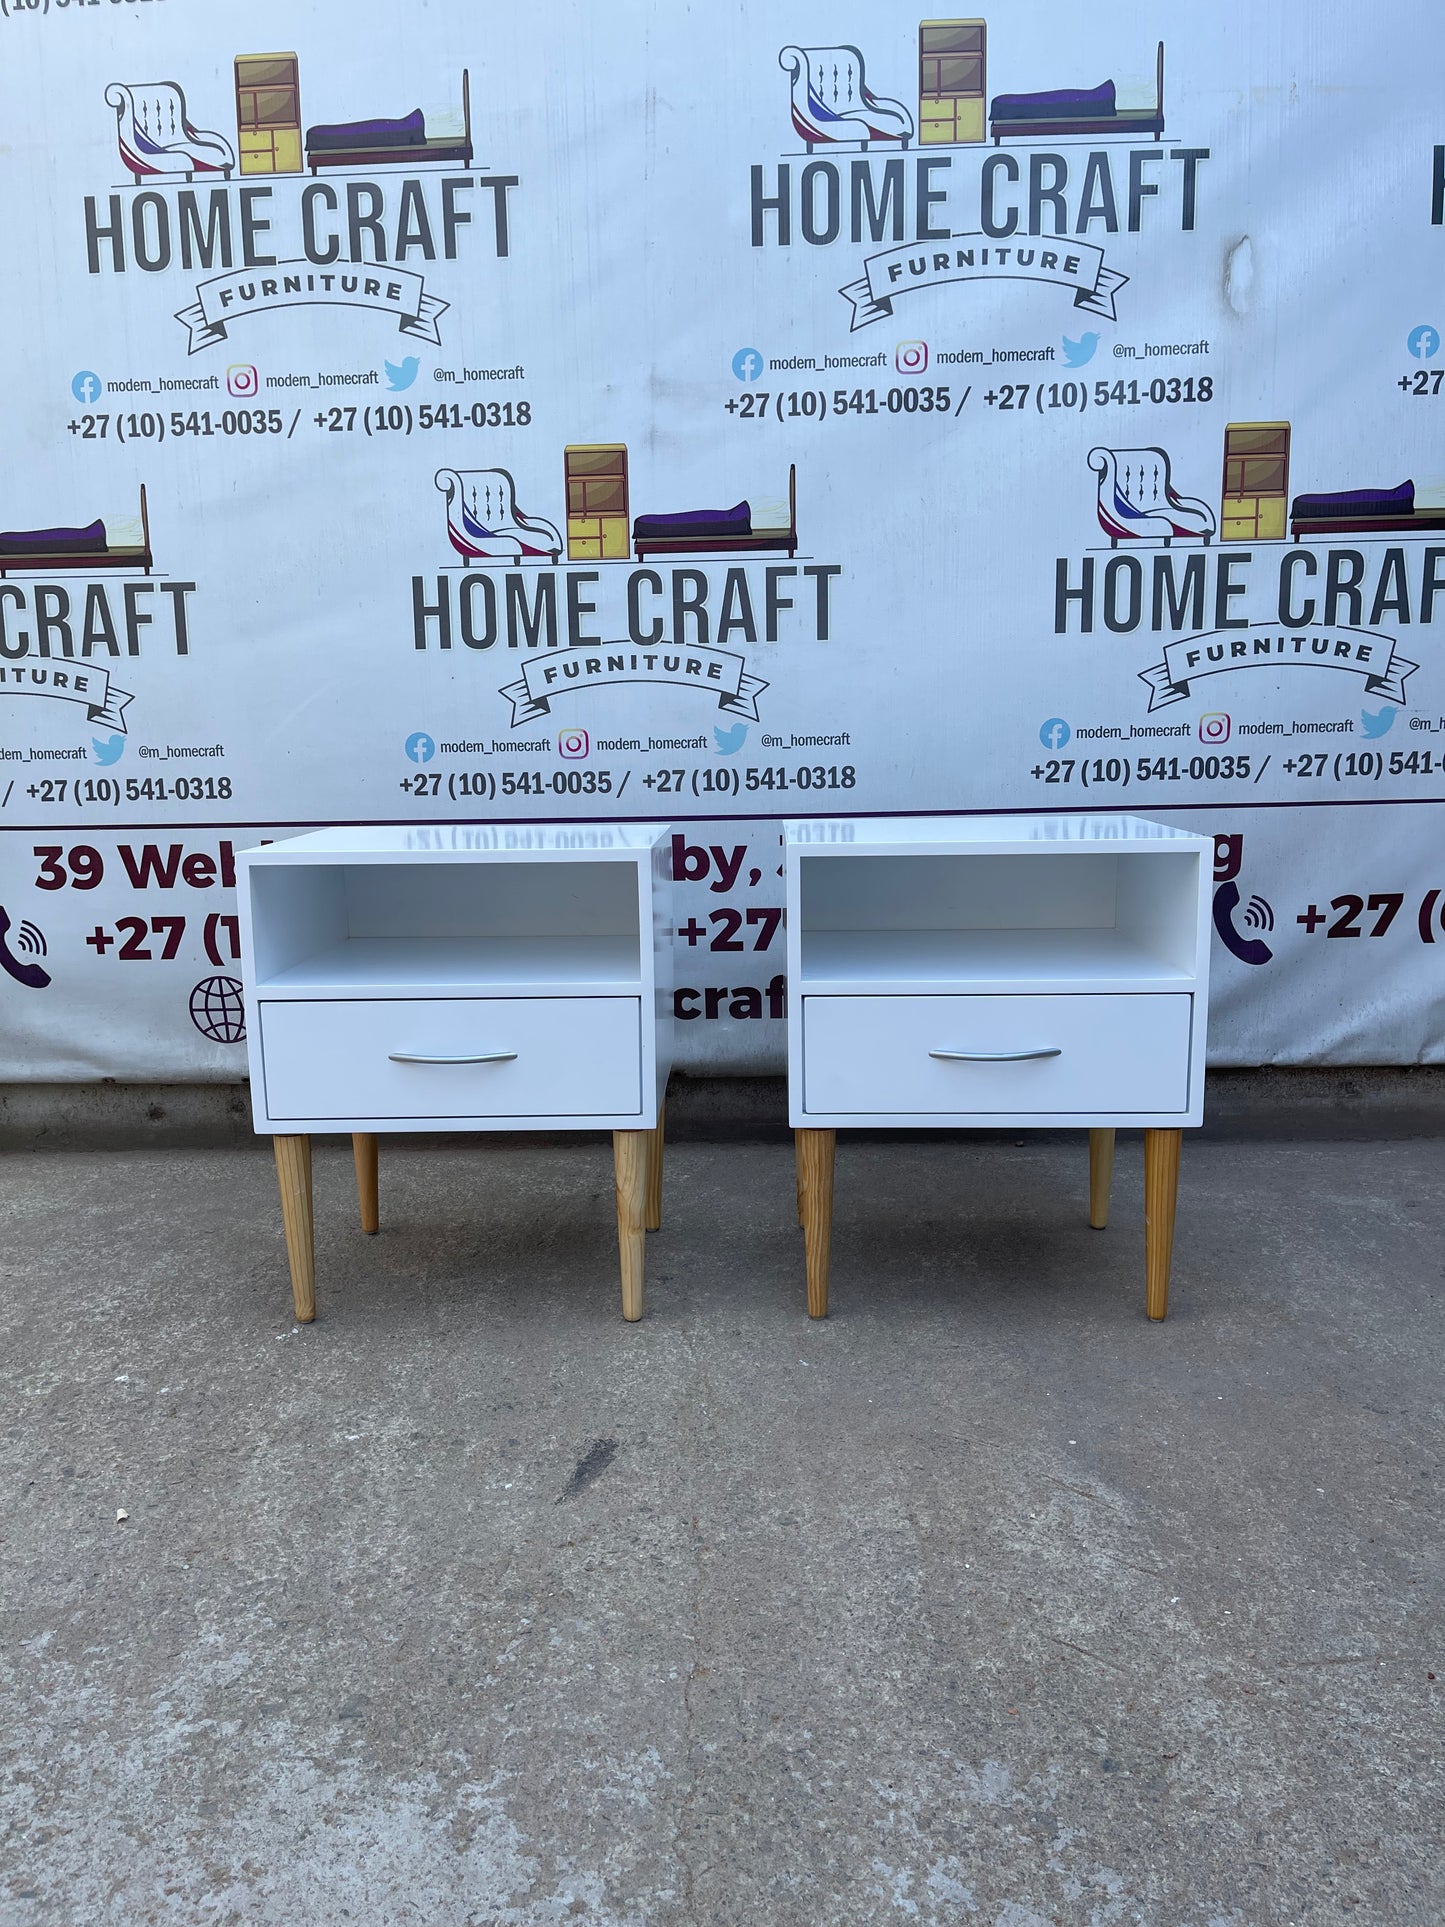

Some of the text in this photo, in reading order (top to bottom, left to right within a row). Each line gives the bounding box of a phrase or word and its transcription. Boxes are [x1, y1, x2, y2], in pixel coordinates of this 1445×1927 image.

[751, 147, 1211, 247] HOME CRAFT
[84, 176, 520, 273] HOME CRAFT
[888, 248, 1081, 283] FURNITURE
[219, 274, 402, 308] FURNITURE
[1113, 340, 1209, 359] @m_homecraft
[434, 366, 524, 384] @m_homecraft
[1397, 370, 1445, 396] +27
[725, 377, 1213, 422] +27 (10) 541-0035 / +27 (10) 541-0318
[67, 401, 531, 443] +27 (10) 541-0035 / +27 (10) 541-0318
[412, 565, 842, 649] HOME CRAFT
[1055, 553, 1253, 634] HOME
[0, 582, 197, 658] CRAFT
[544, 654, 723, 684] FURNITURE
[1186, 637, 1373, 668] FURNITURE
[139, 744, 224, 761] @m_homecraft
[762, 732, 850, 750] @m_homecraft
[400, 766, 855, 800] +27 (10) 541-0035 / +27 (10) 541-0318
[1031, 751, 1445, 787] +27 (10) 541-0035 / +27 (10) 541-
[27, 779, 68, 803] +27
[74, 778, 121, 806] (10)
[126, 777, 232, 801] 541-0318
[34, 845, 104, 891] 39
[678, 908, 782, 952] +27
[1297, 893, 1404, 939] +27
[86, 916, 187, 960] +27
